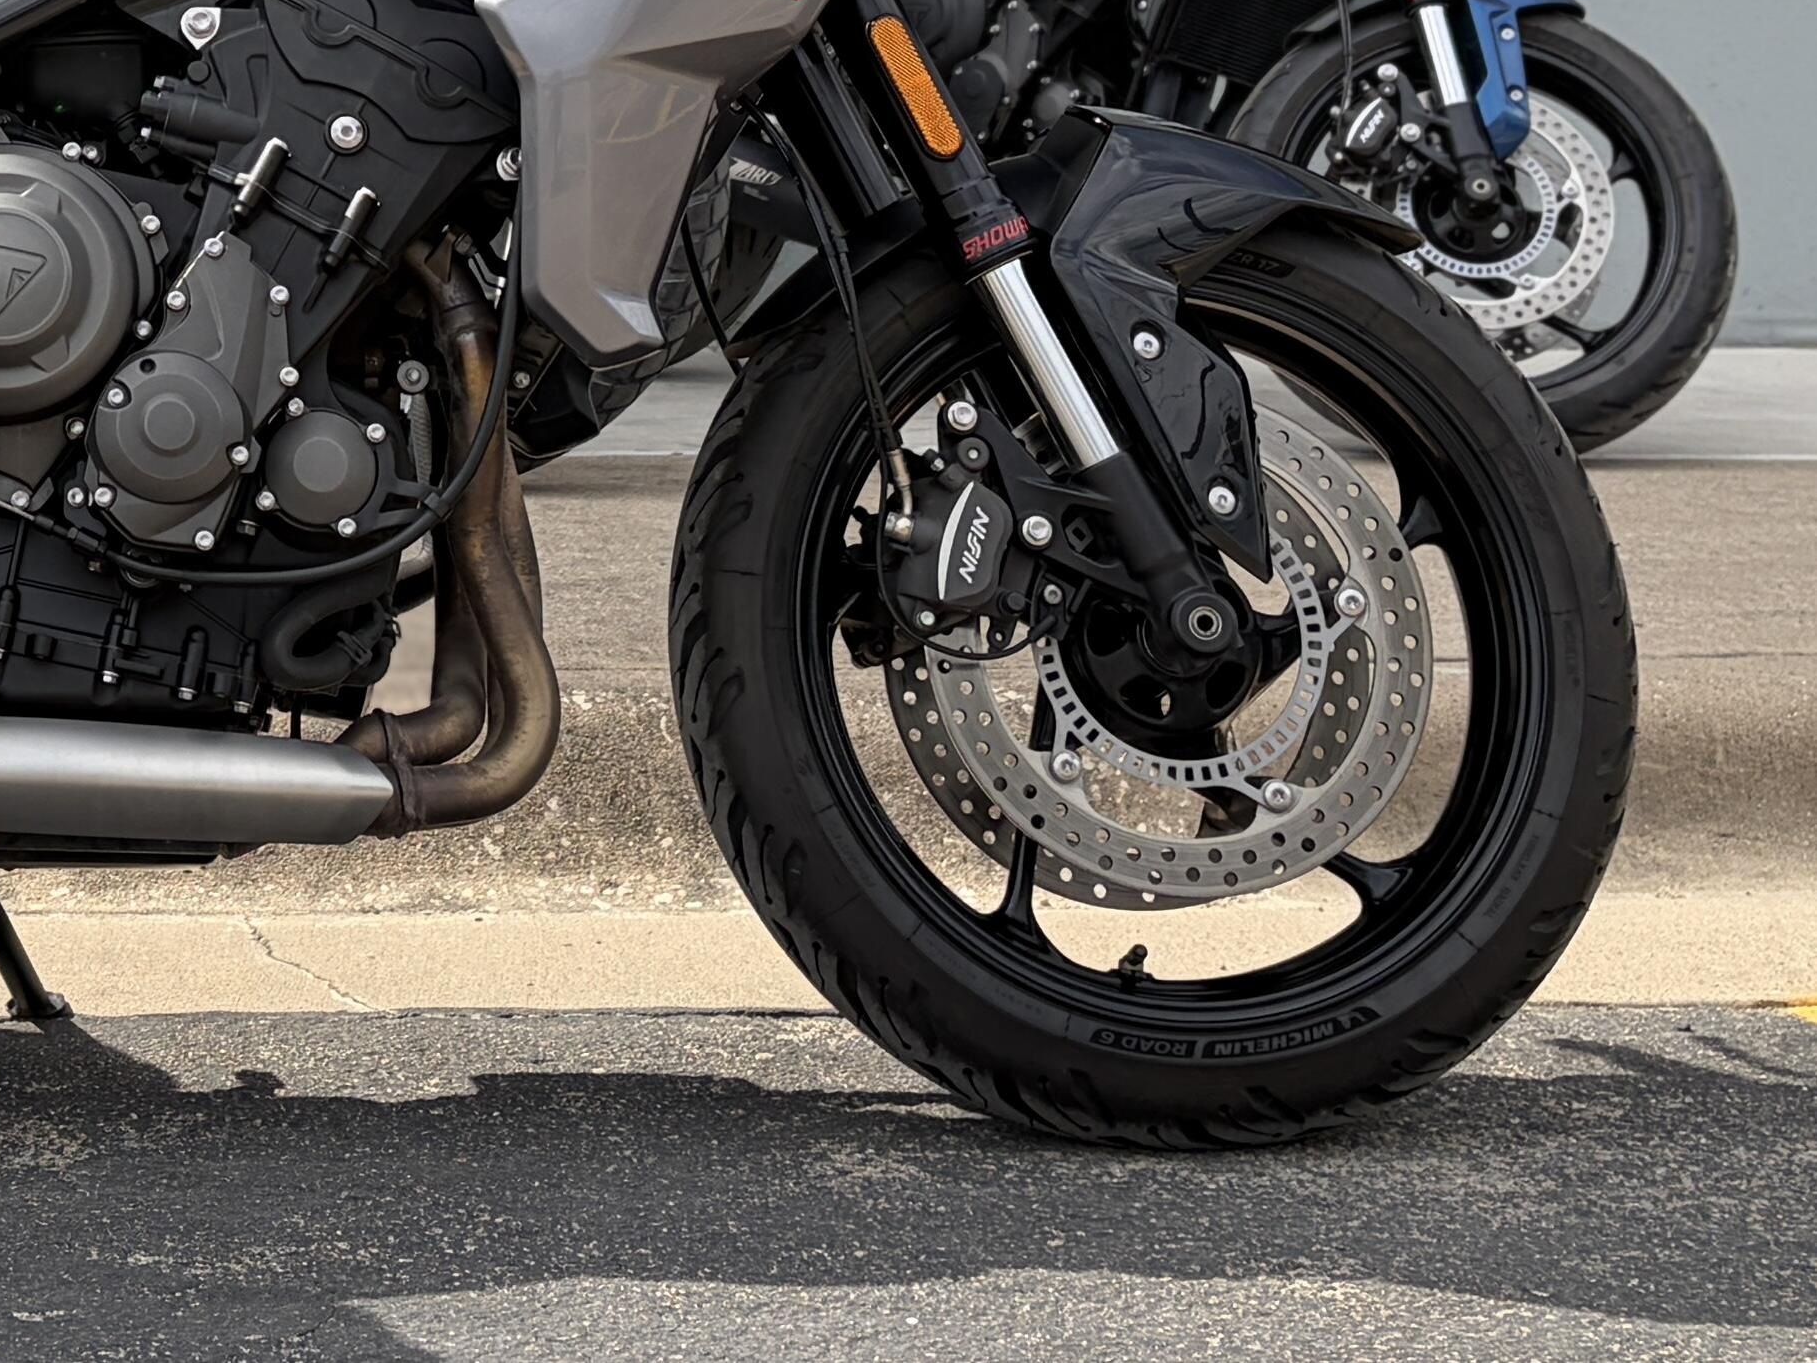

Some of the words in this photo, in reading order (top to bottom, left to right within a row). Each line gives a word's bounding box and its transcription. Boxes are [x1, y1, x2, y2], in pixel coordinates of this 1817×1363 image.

[962, 215, 1030, 262] SHOWA
[958, 506, 991, 584] NISSIN
[1097, 1029, 1114, 1045] 6
[1120, 1033, 1188, 1057] ROAD
[1213, 1021, 1335, 1057] MICHELIN
